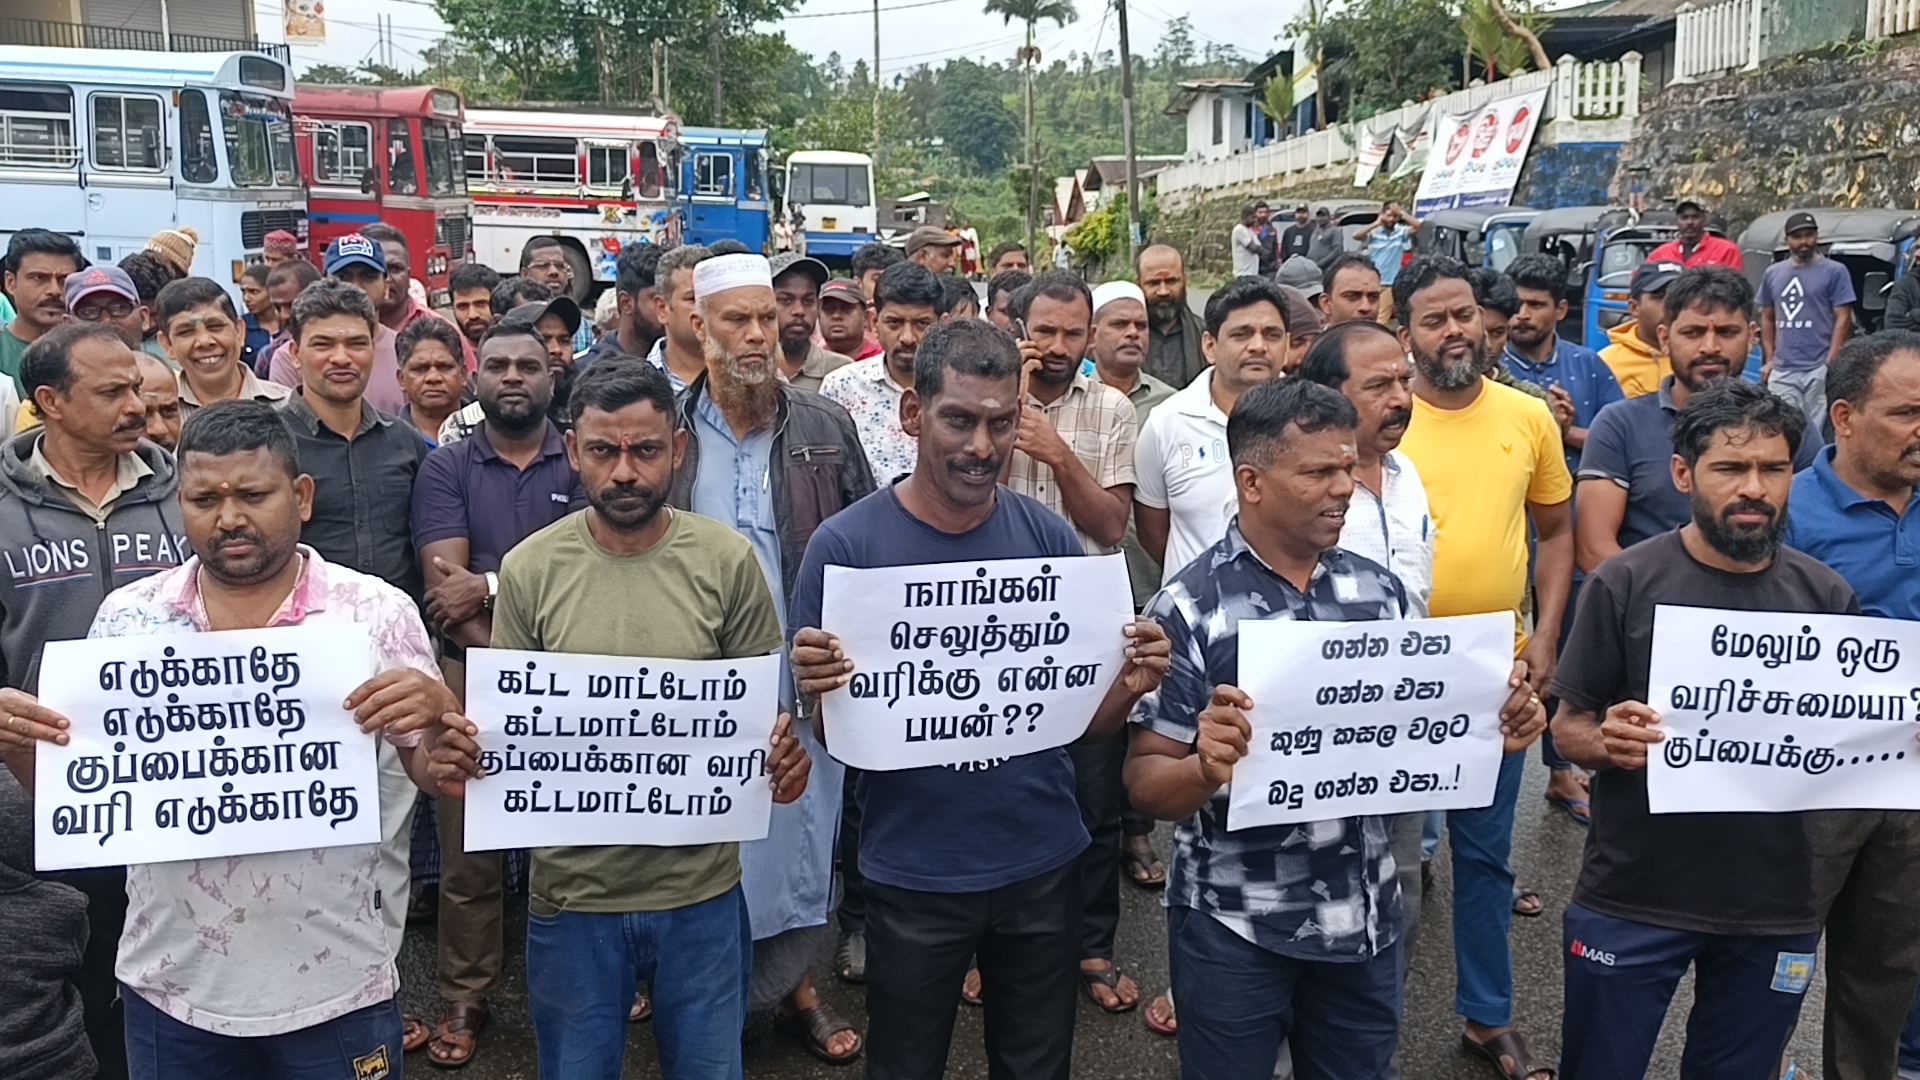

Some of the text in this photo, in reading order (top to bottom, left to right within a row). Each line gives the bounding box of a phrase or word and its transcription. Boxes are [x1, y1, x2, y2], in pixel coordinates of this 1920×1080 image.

[498, 205, 561, 218] Service
[4, 533, 188, 579] LIONS PEAK
[904, 563, 1062, 608] நாங்கள்
[890, 611, 1070, 659] செலுத்தும்
[1321, 630, 1451, 660] ගන්න එපා
[1711, 624, 1900, 678] மேலும் ஒரு
[99, 645, 301, 699] எடுக்காதே
[497, 660, 747, 701] கட்ட மாட்டோம்
[848, 655, 1103, 710] வரிக்கு என்ன
[1315, 677, 1445, 706] ගන්න එපා
[103, 692, 306, 744] எடுக்காதே
[503, 705, 738, 739] கட்டமாட்டோம்
[904, 702, 1045, 743] பயன்??
[1332, 724, 1398, 748] කසල
[1407, 713, 1470, 745] වලට
[66, 735, 342, 794] குப்பைக்கான
[707, 748, 766, 787] வரி
[503, 780, 733, 816] கட்டமாட்டோம்
[1267, 763, 1461, 811] බදු ගන්න එපා..!
[52, 779, 359, 847] வரி எடுக்காதே
[1581, 945, 1616, 967] MAS
